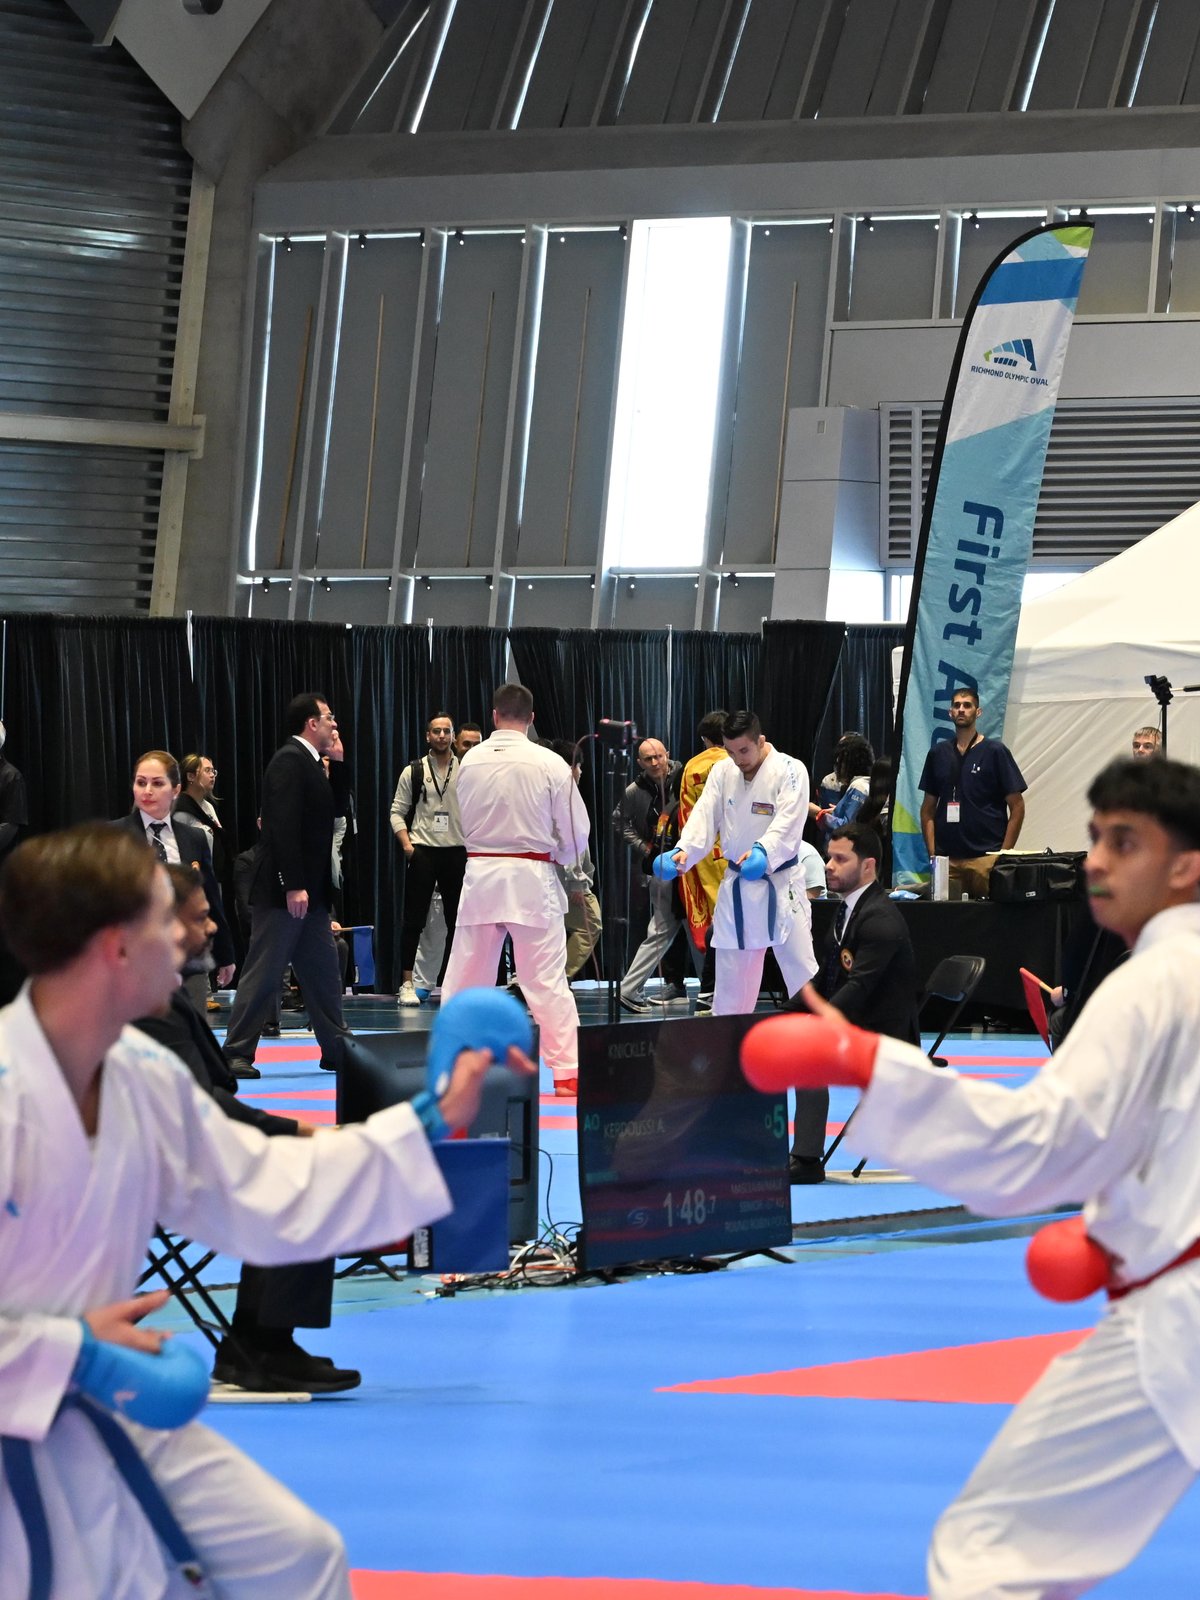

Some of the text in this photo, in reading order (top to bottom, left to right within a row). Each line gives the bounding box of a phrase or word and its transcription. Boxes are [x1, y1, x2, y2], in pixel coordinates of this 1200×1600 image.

[970, 365, 1049, 386] RICHMOND OLYMPIC OVAL
[942, 500, 1005, 646] First
[584, 1113, 600, 1131] AO
[773, 1103, 785, 1139] 5
